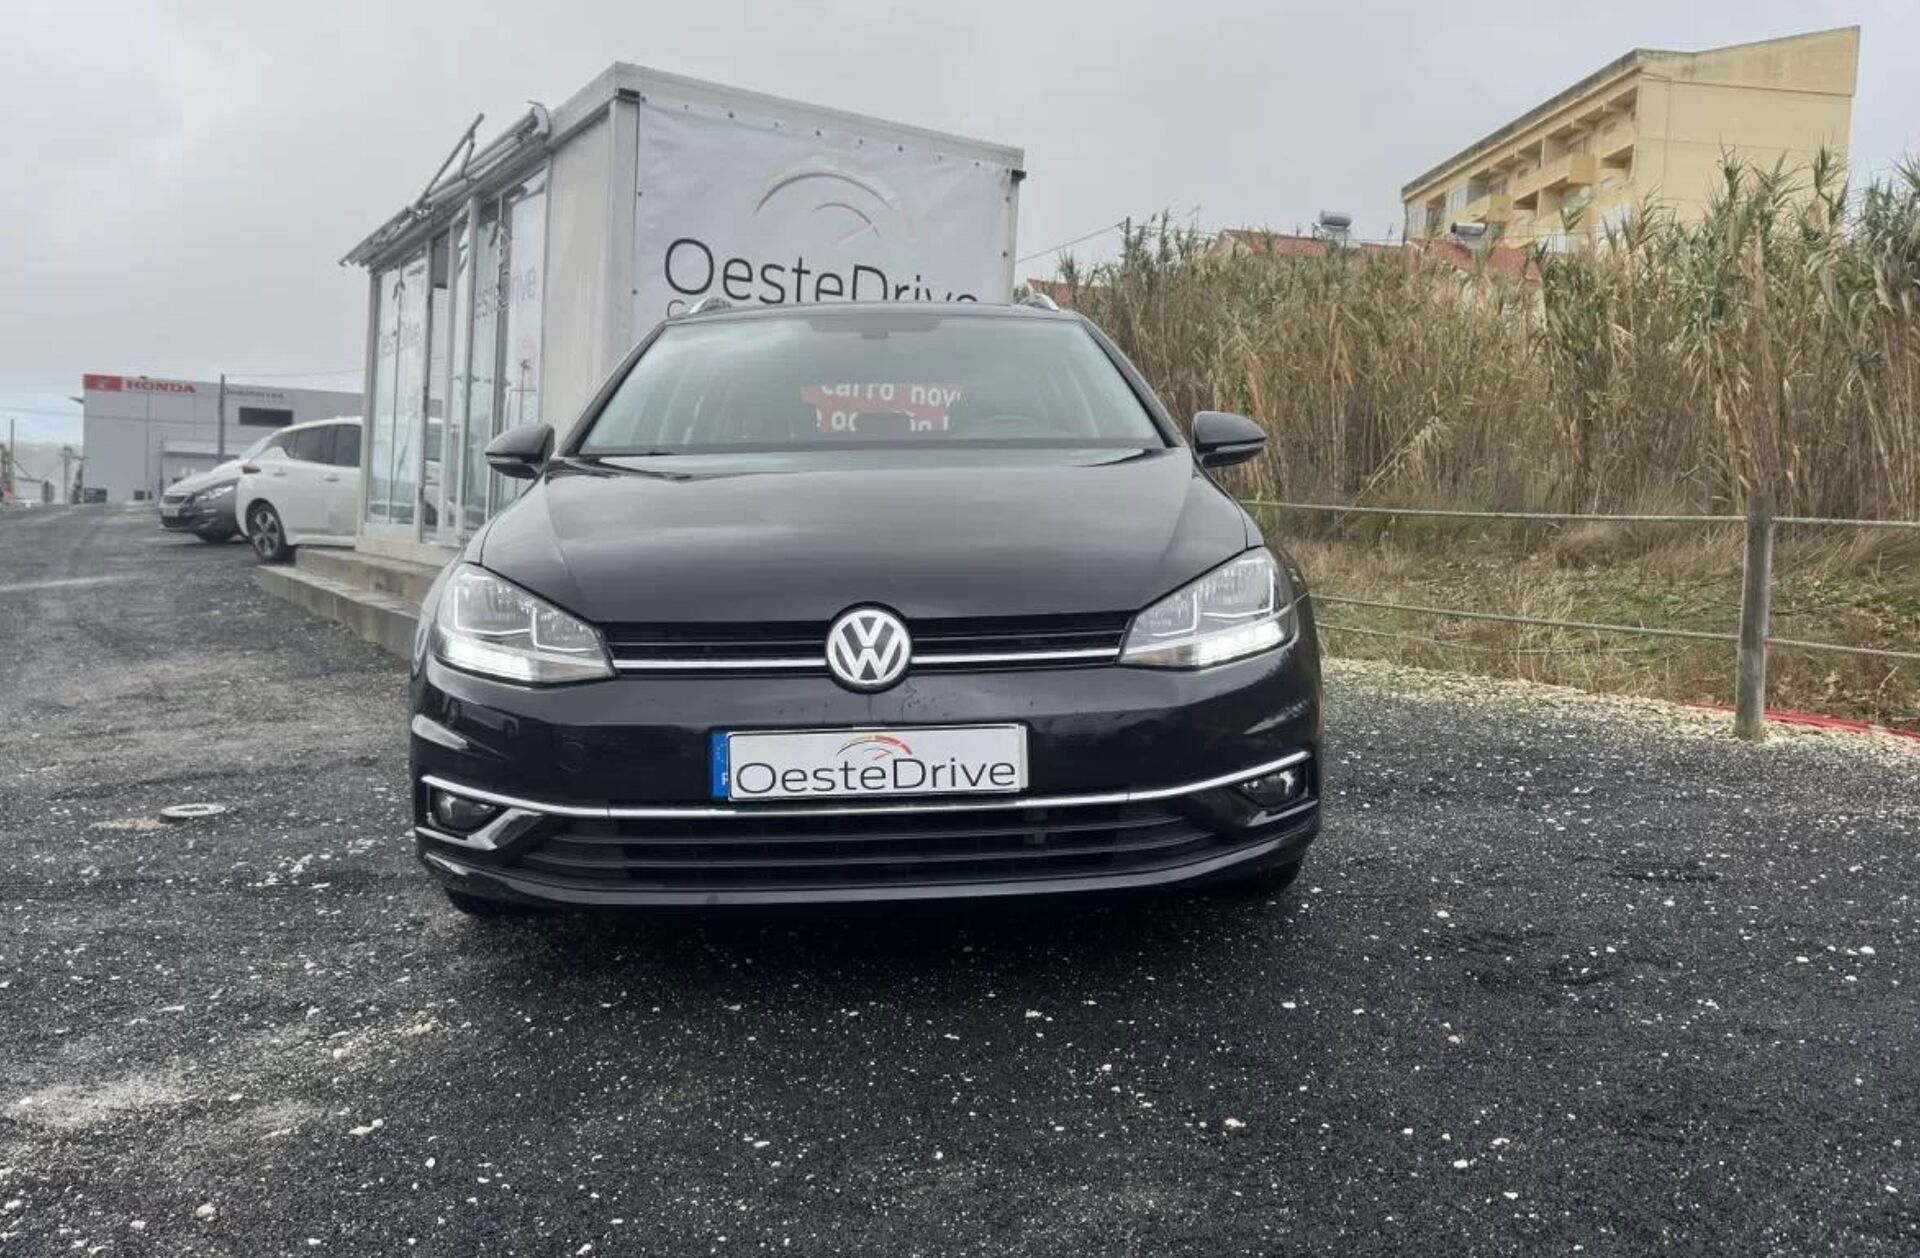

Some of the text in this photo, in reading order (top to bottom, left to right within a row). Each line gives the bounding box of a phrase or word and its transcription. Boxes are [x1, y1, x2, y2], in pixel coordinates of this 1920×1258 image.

[664, 237, 978, 304] OesteDri
[126, 380, 196, 394] HONDA
[736, 757, 1016, 794] OesteDrive
